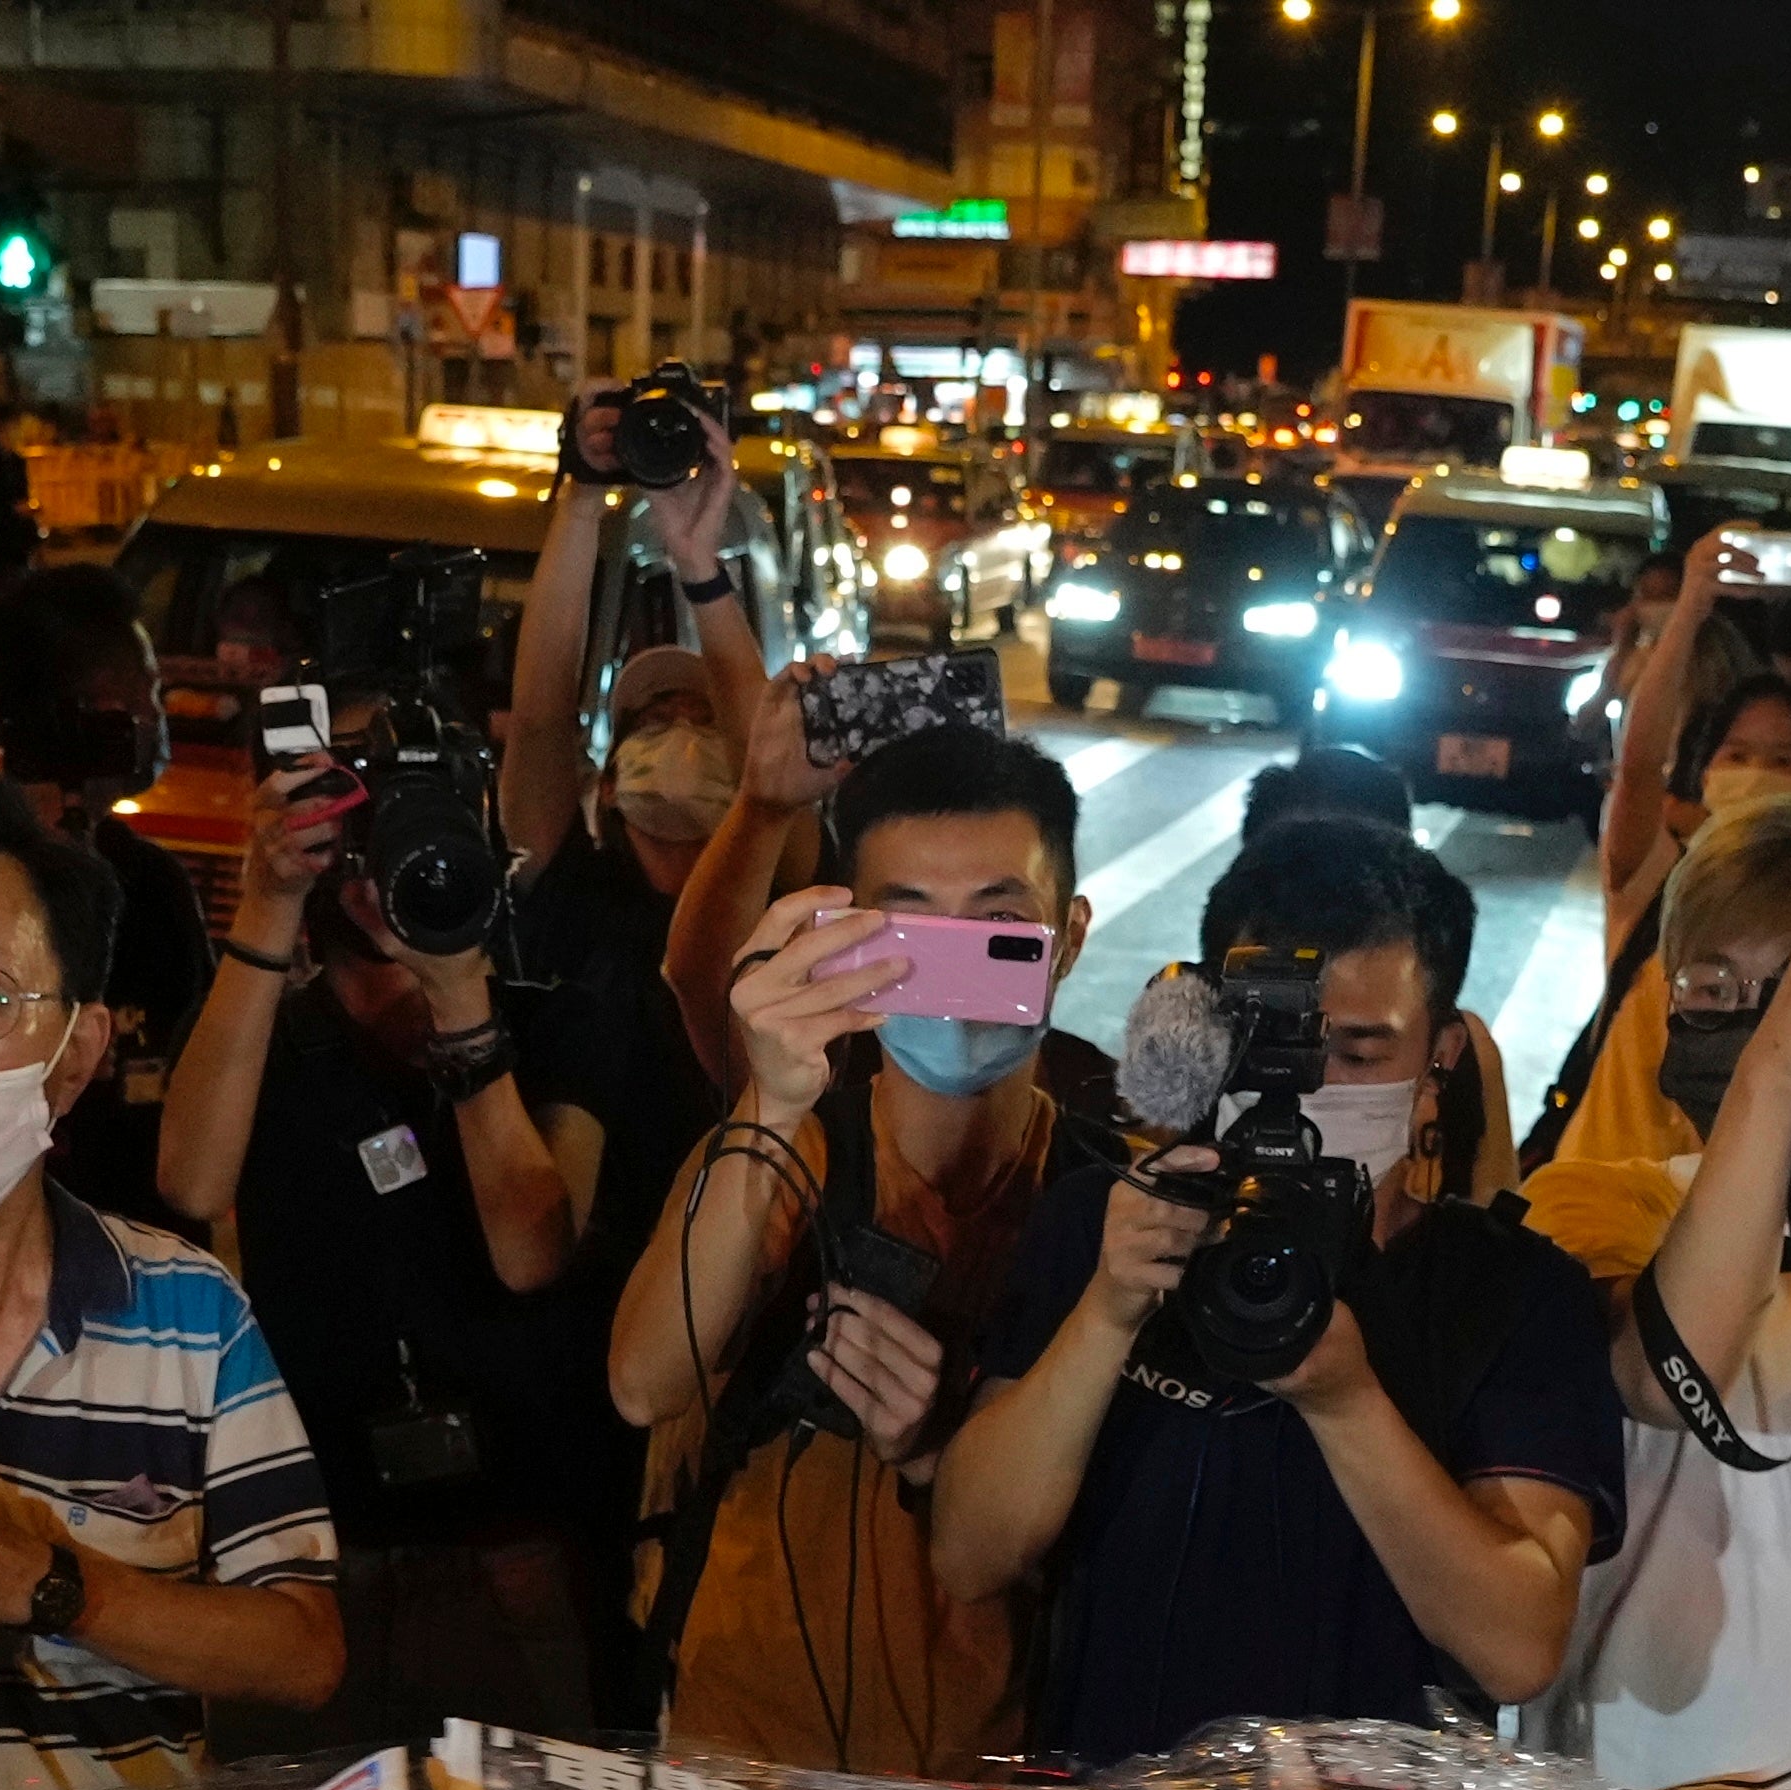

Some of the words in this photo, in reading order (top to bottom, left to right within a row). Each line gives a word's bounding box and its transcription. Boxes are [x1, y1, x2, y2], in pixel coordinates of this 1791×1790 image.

[1255, 1145, 1296, 1158] SONY
[1121, 1362, 1213, 1409] SON
[1662, 1355, 1735, 1448] SONY
